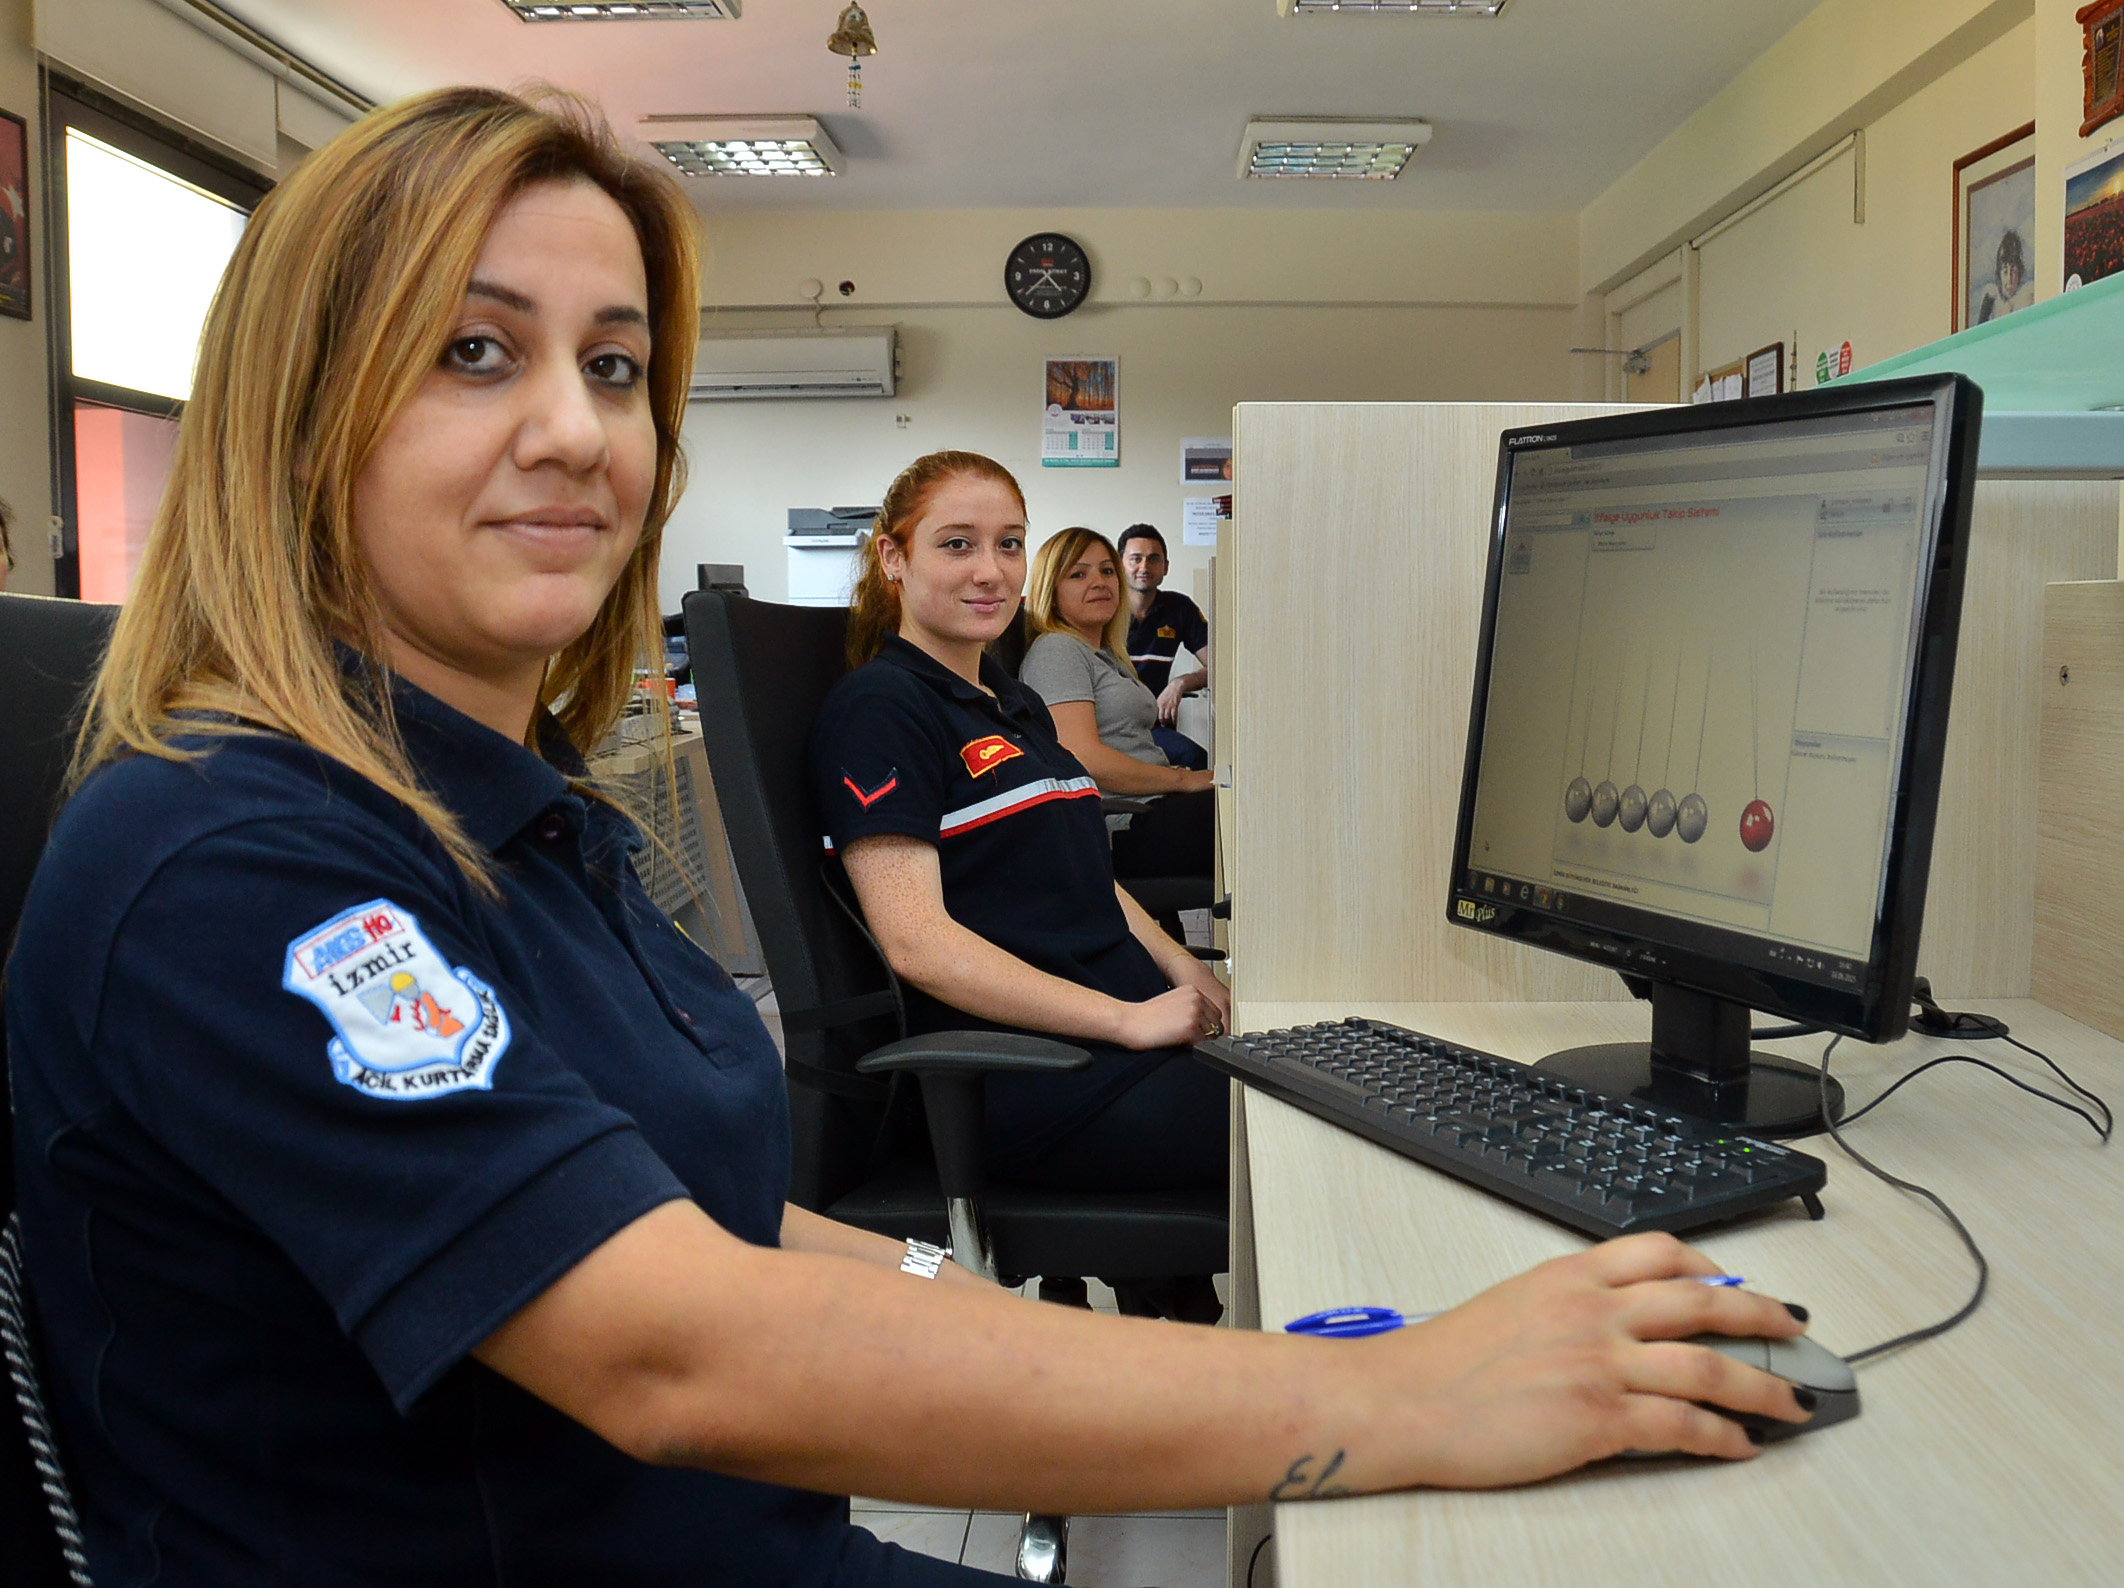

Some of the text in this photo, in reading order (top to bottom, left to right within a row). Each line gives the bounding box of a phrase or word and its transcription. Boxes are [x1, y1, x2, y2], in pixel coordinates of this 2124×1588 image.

[1042, 242, 1053, 252] 12
[1015, 271, 1021, 281] 9
[1073, 271, 1080, 281] 3
[1043, 299, 1050, 309] 6
[1508, 434, 1543, 446] FLATRON
[1458, 901, 1496, 922] Mr plus
[363, 914, 393, 943] 110
